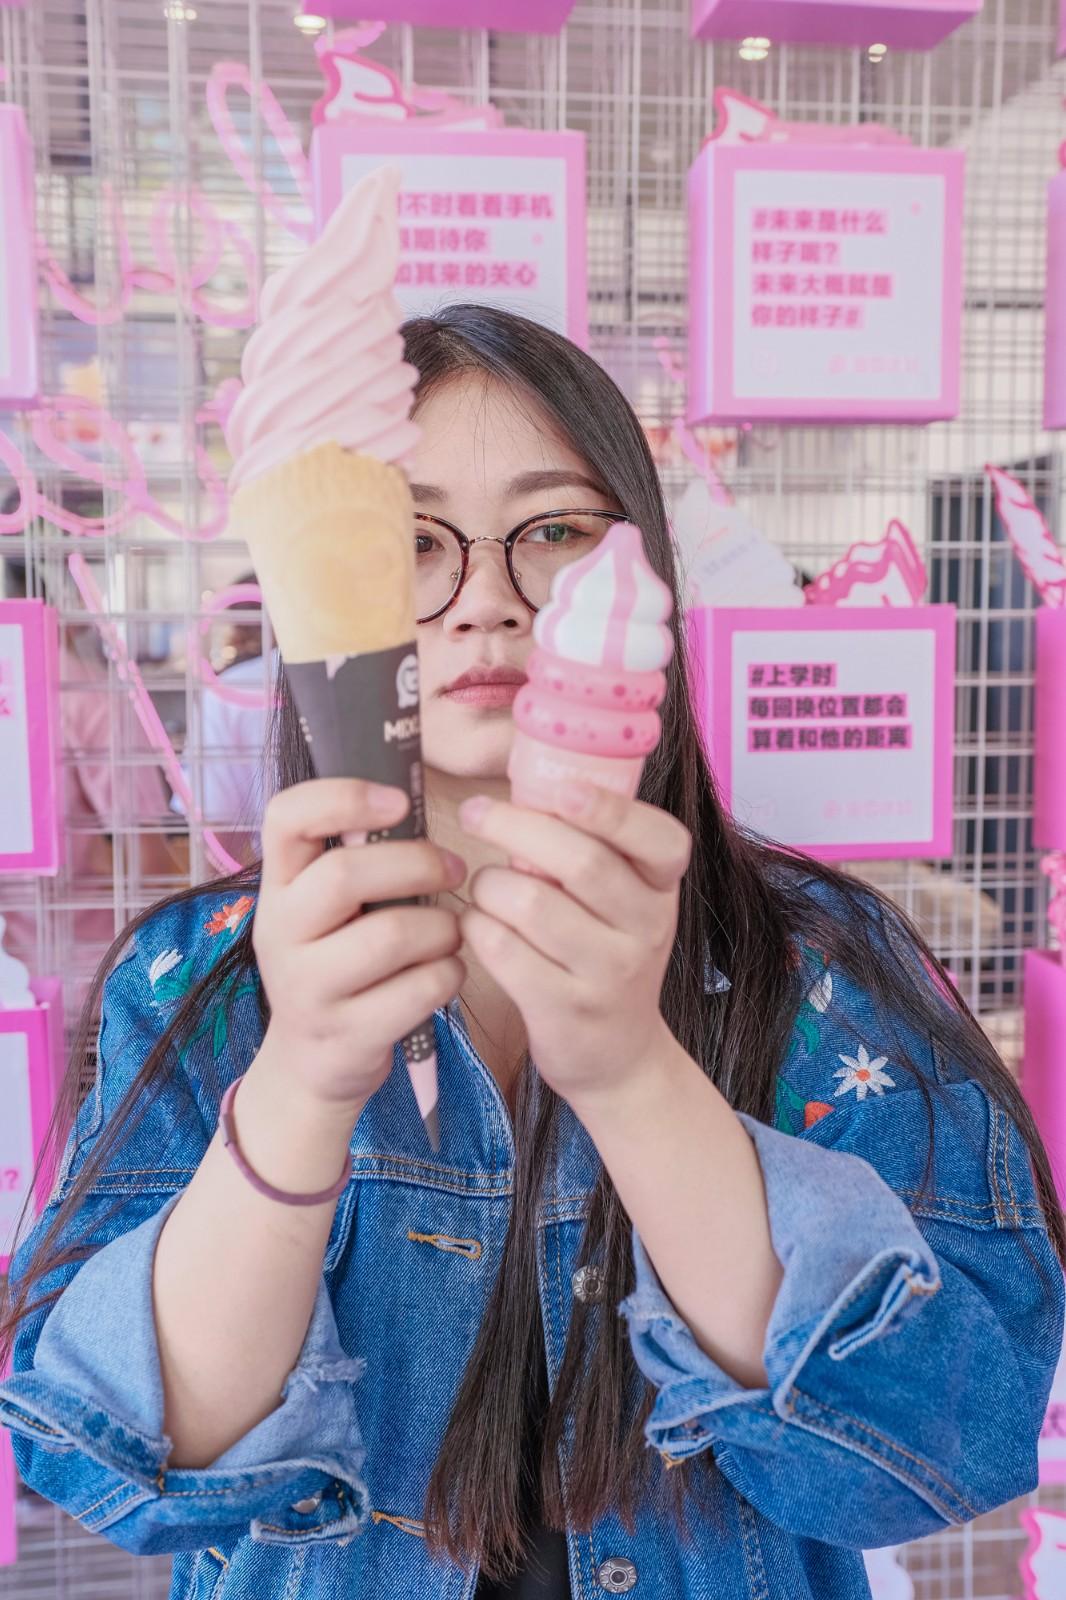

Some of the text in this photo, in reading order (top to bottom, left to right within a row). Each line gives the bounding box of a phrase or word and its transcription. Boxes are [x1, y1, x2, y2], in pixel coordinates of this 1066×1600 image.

[397, 192, 553, 219] 不时看看手机
[753, 208, 885, 233] #未来是什么
[754, 271, 892, 297] 未来大概就是
[752, 303, 860, 328] 你的样子#
[751, 665, 833, 687] #上学时
[751, 694, 906, 719] 每回换位置都会
[752, 725, 908, 750] 算着和他的距离
